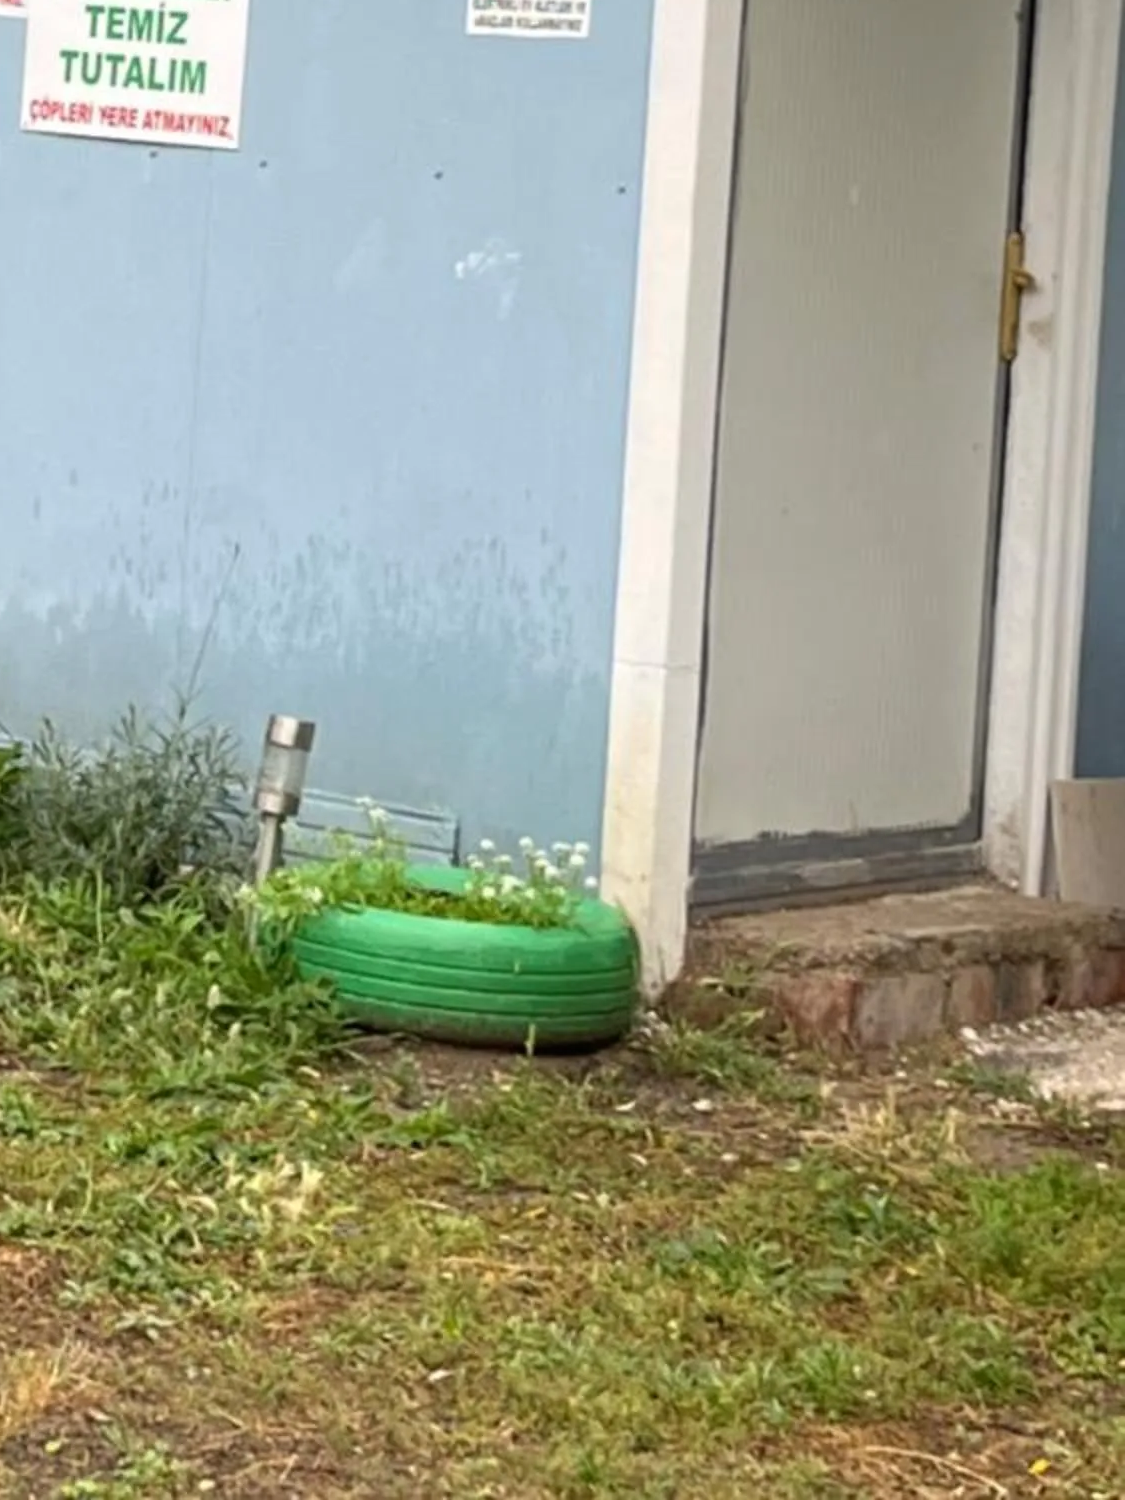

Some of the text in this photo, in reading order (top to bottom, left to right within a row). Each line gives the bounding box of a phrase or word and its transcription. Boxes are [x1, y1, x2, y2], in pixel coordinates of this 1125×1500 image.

[85, 2, 189, 45] TEMİZ
[60, 49, 207, 95] TUTALIM
[30, 97, 94, 124] ÇÖPLERİ
[98, 105, 139, 129] YERE
